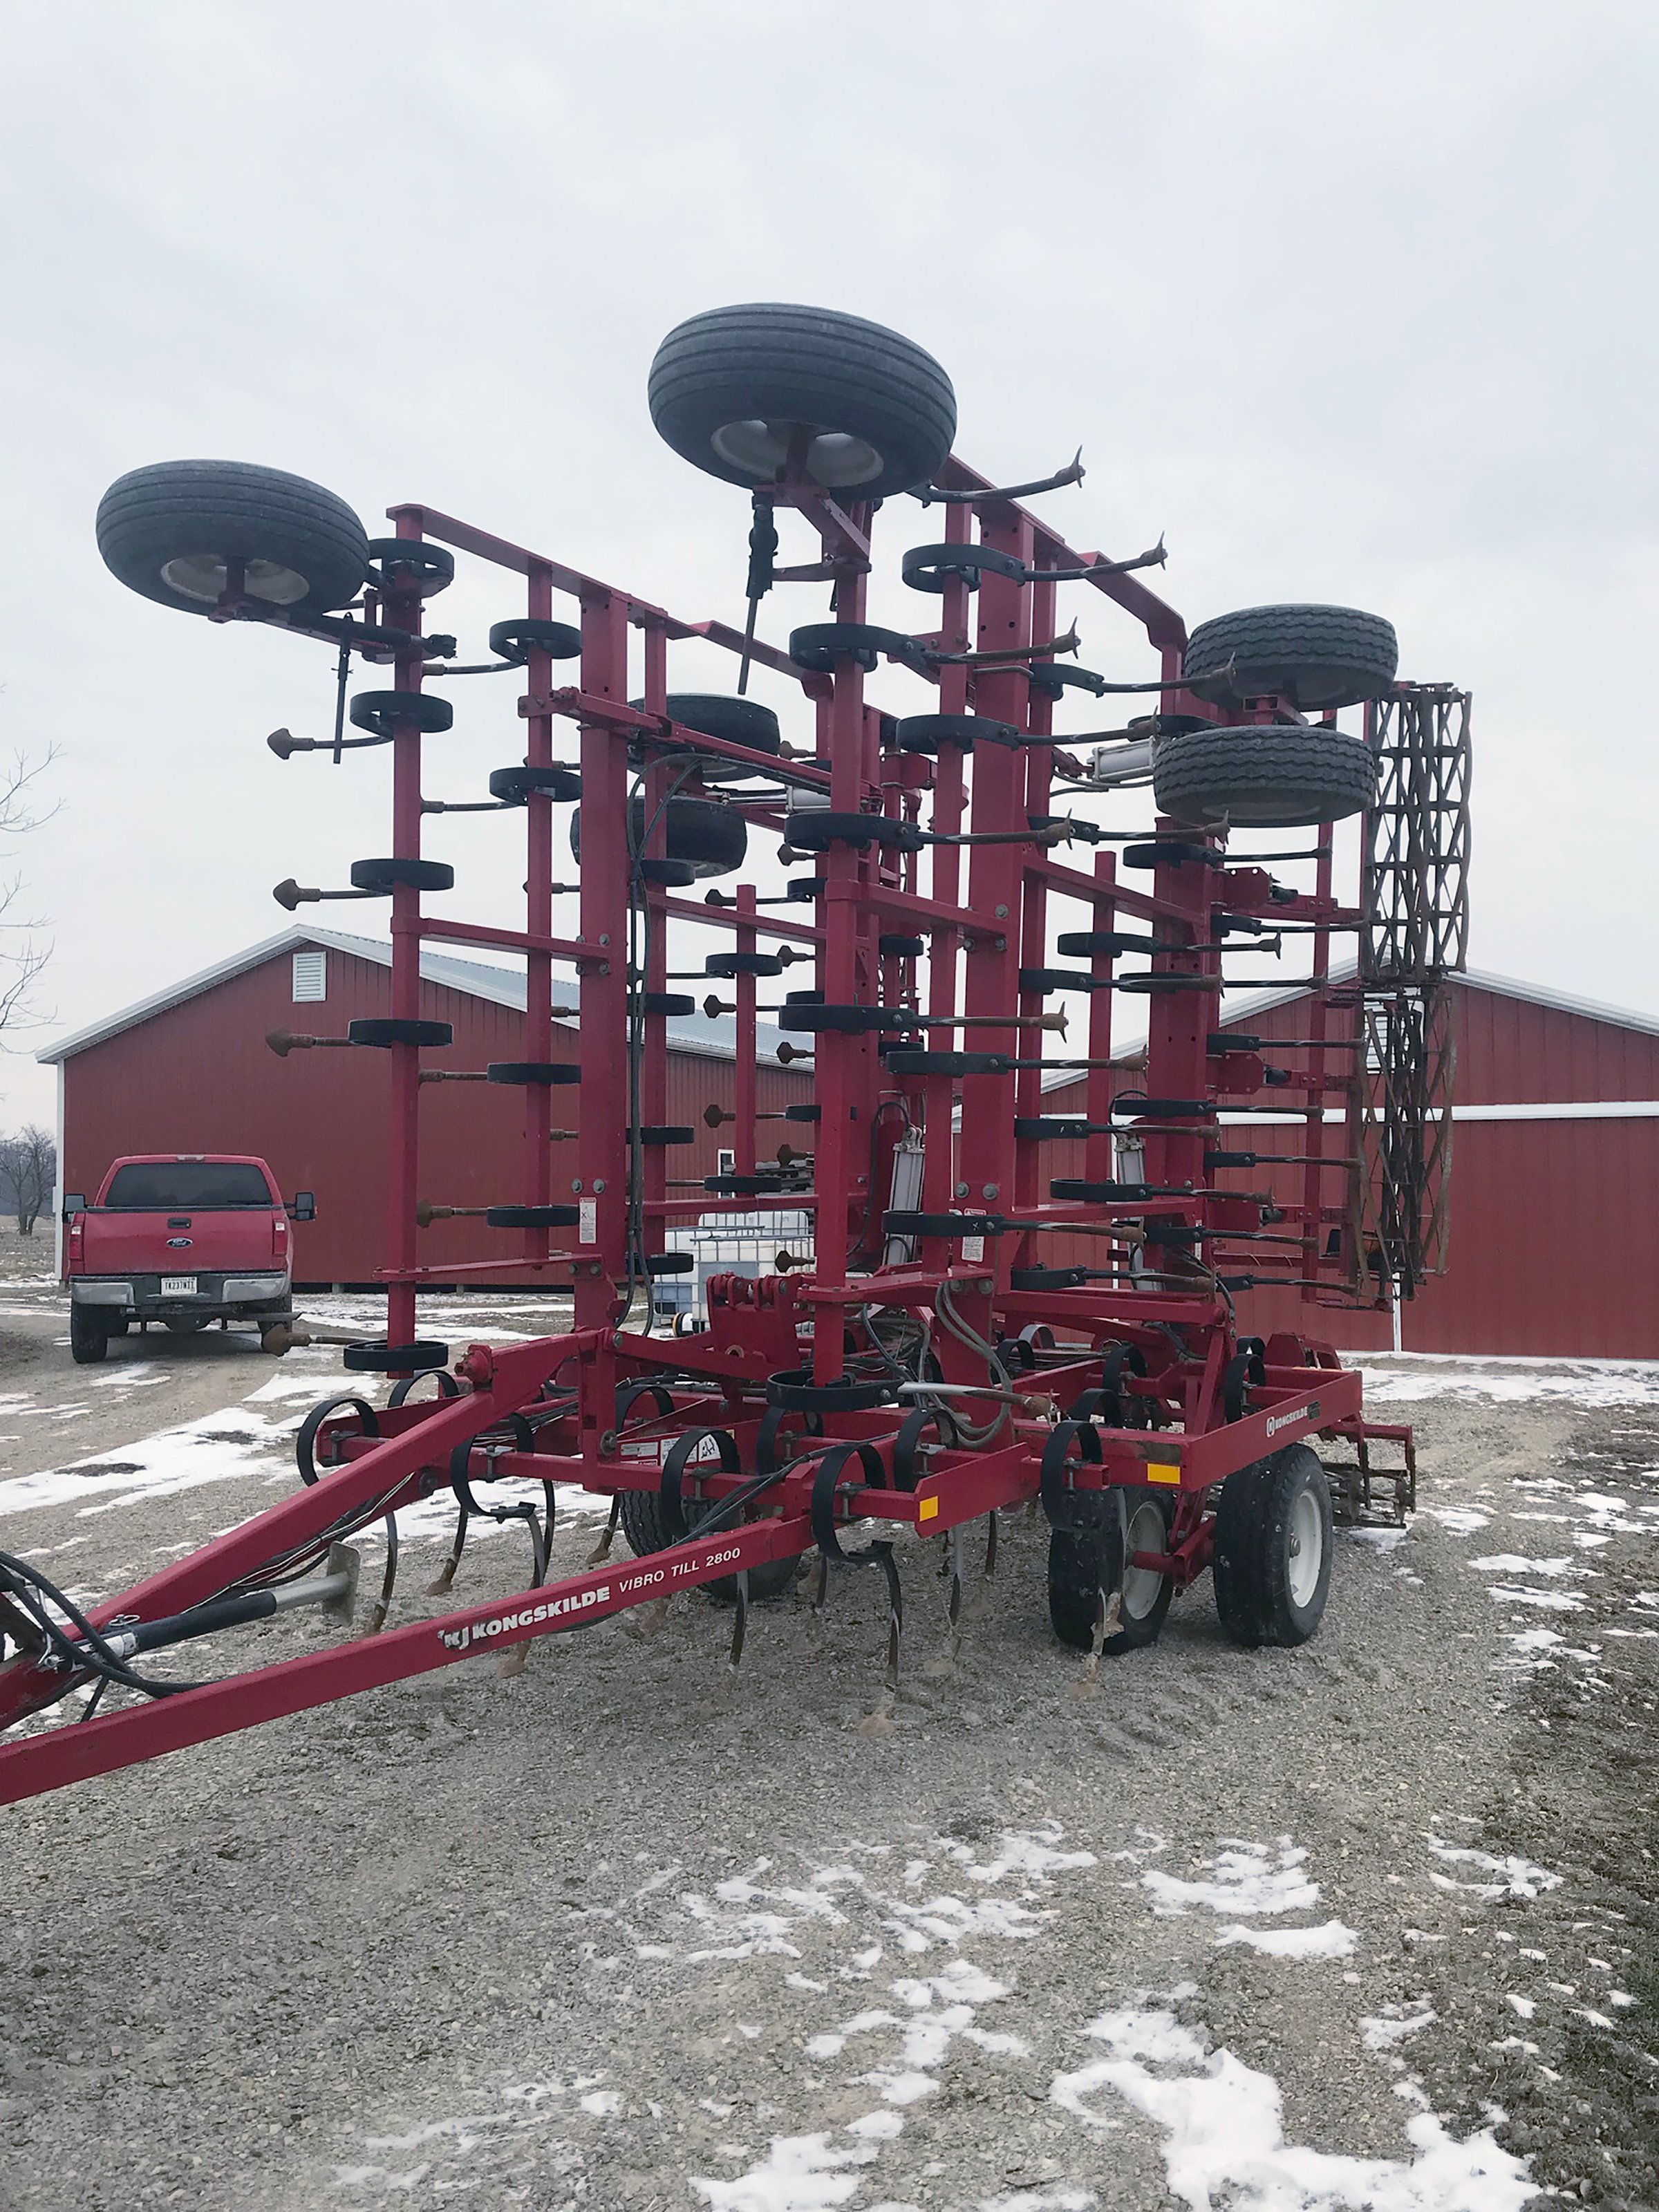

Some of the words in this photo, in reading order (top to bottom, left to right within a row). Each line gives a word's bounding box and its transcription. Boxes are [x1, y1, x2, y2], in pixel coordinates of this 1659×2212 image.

[472, 1586, 610, 1640] KONGSKILDE
[619, 1570, 665, 1593] VIBRO
[671, 1560, 700, 1577] TILL
[705, 1548, 740, 1567] 2800
